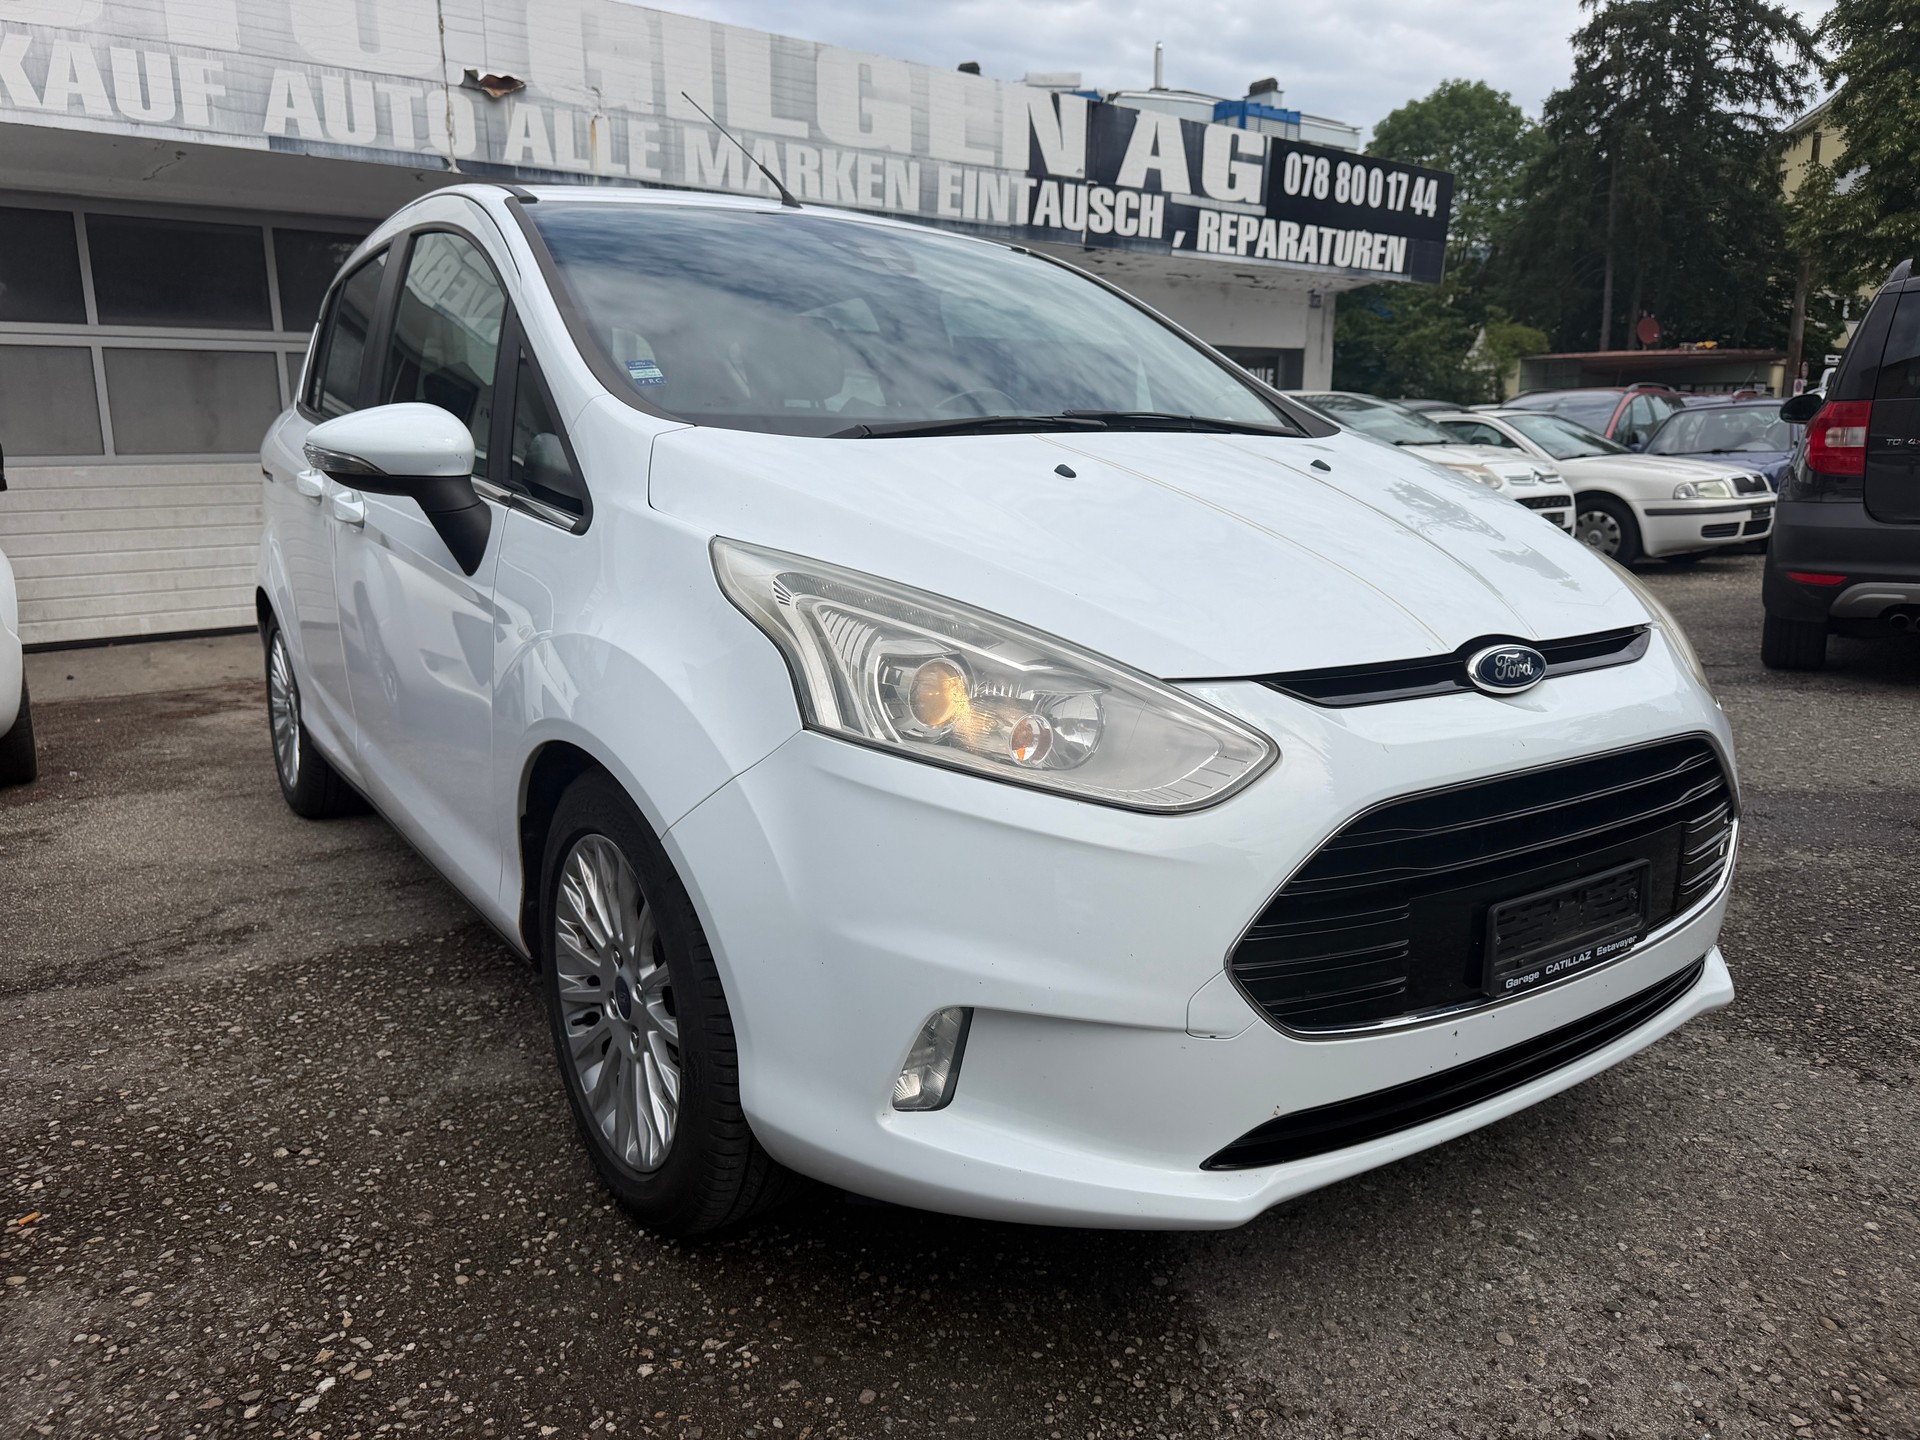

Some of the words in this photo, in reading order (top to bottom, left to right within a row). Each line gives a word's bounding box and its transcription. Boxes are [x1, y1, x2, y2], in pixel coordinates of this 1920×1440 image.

[263, 69, 476, 157] AUTO
[503, 102, 664, 178] ALLE
[683, 126, 920, 209] MARKEN
[937, 164, 1165, 239] EINTAUSCH
[1197, 212, 1408, 273] REPARATUREN
[1115, 111, 1266, 204] AG
[1283, 151, 1331, 200] 078
[1494, 652, 1534, 681] Ford
[1505, 971, 1540, 989] Garage
[1545, 951, 1592, 975] CATILLAZ
[1596, 935, 1637, 957] Estavayer
